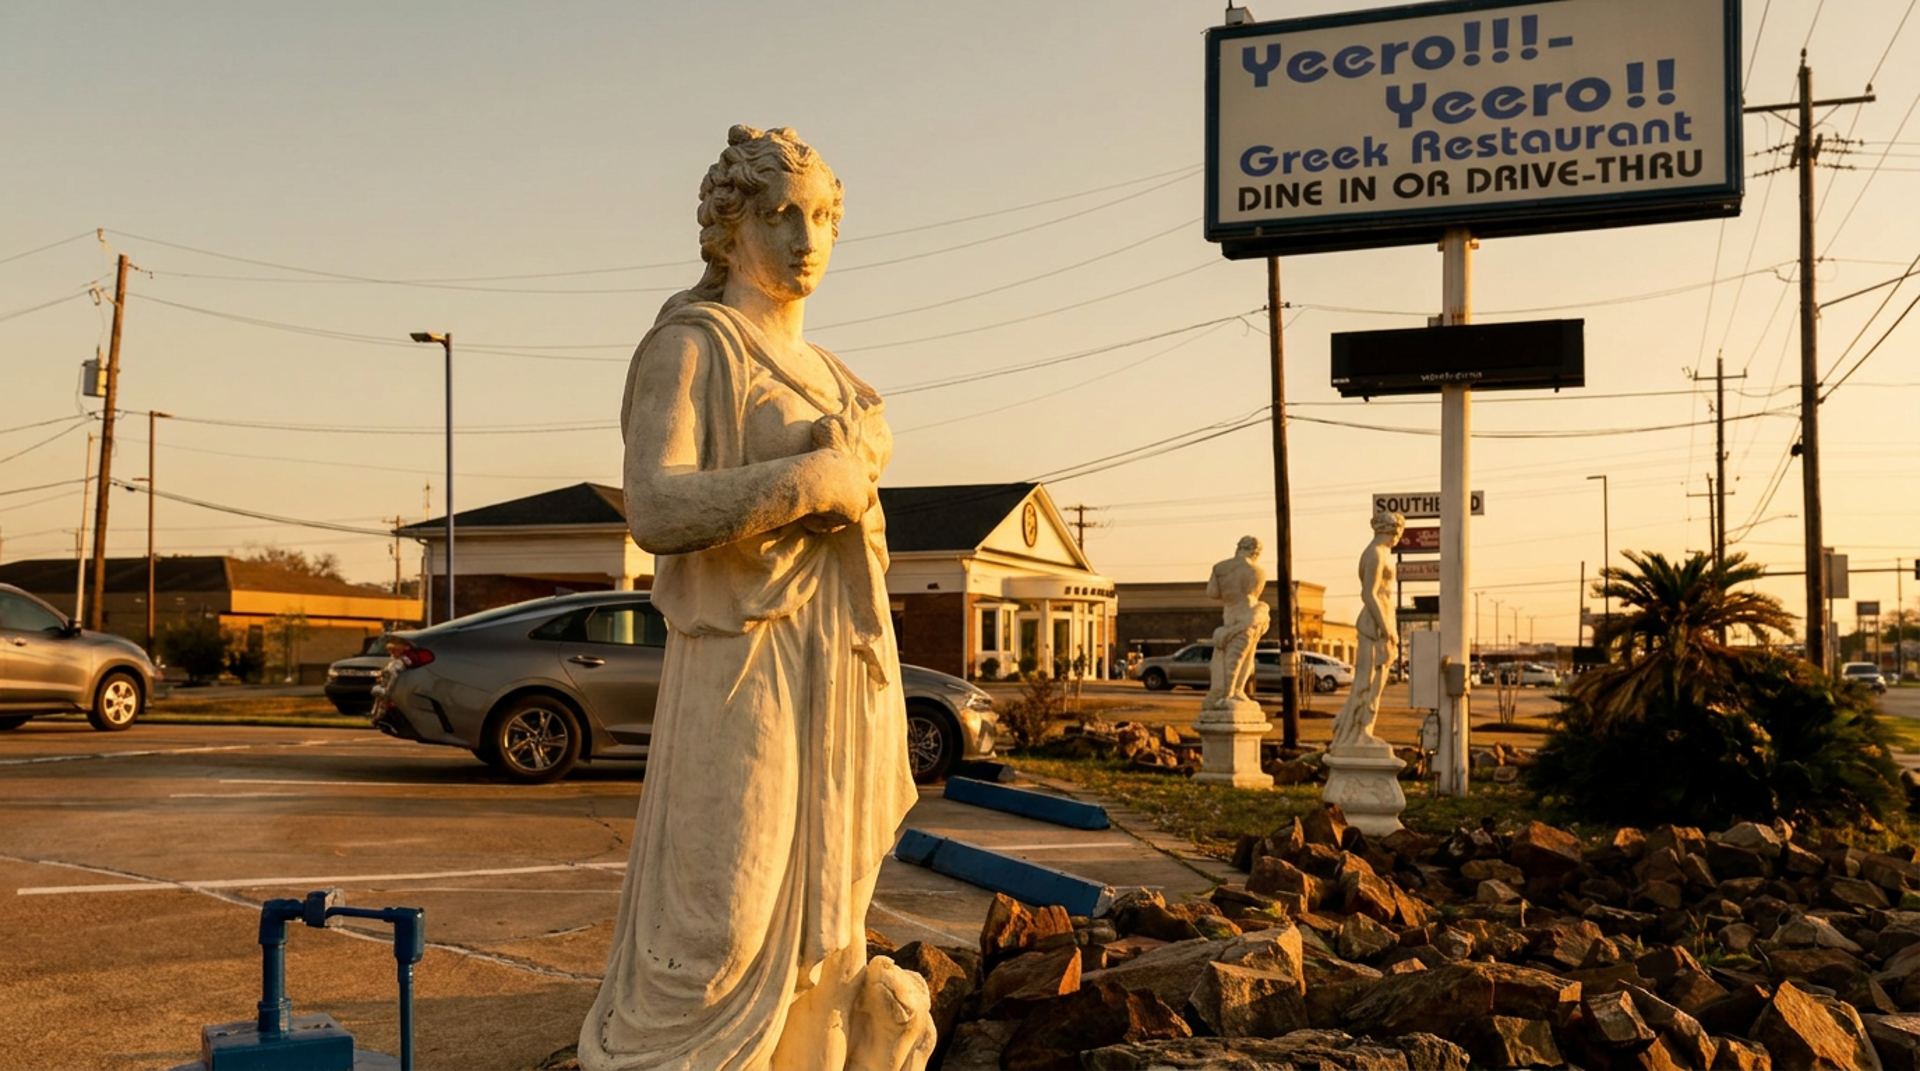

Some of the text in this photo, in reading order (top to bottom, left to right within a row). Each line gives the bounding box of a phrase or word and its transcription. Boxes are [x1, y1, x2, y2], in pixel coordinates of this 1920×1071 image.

[1242, 14, 1573, 87] Yeero!!!-
[1386, 58, 1676, 128] Yeero!!
[1240, 111, 1692, 177] Greek Restaurant
[1239, 149, 1703, 212] DINE IN OR DRIVE-THRU
